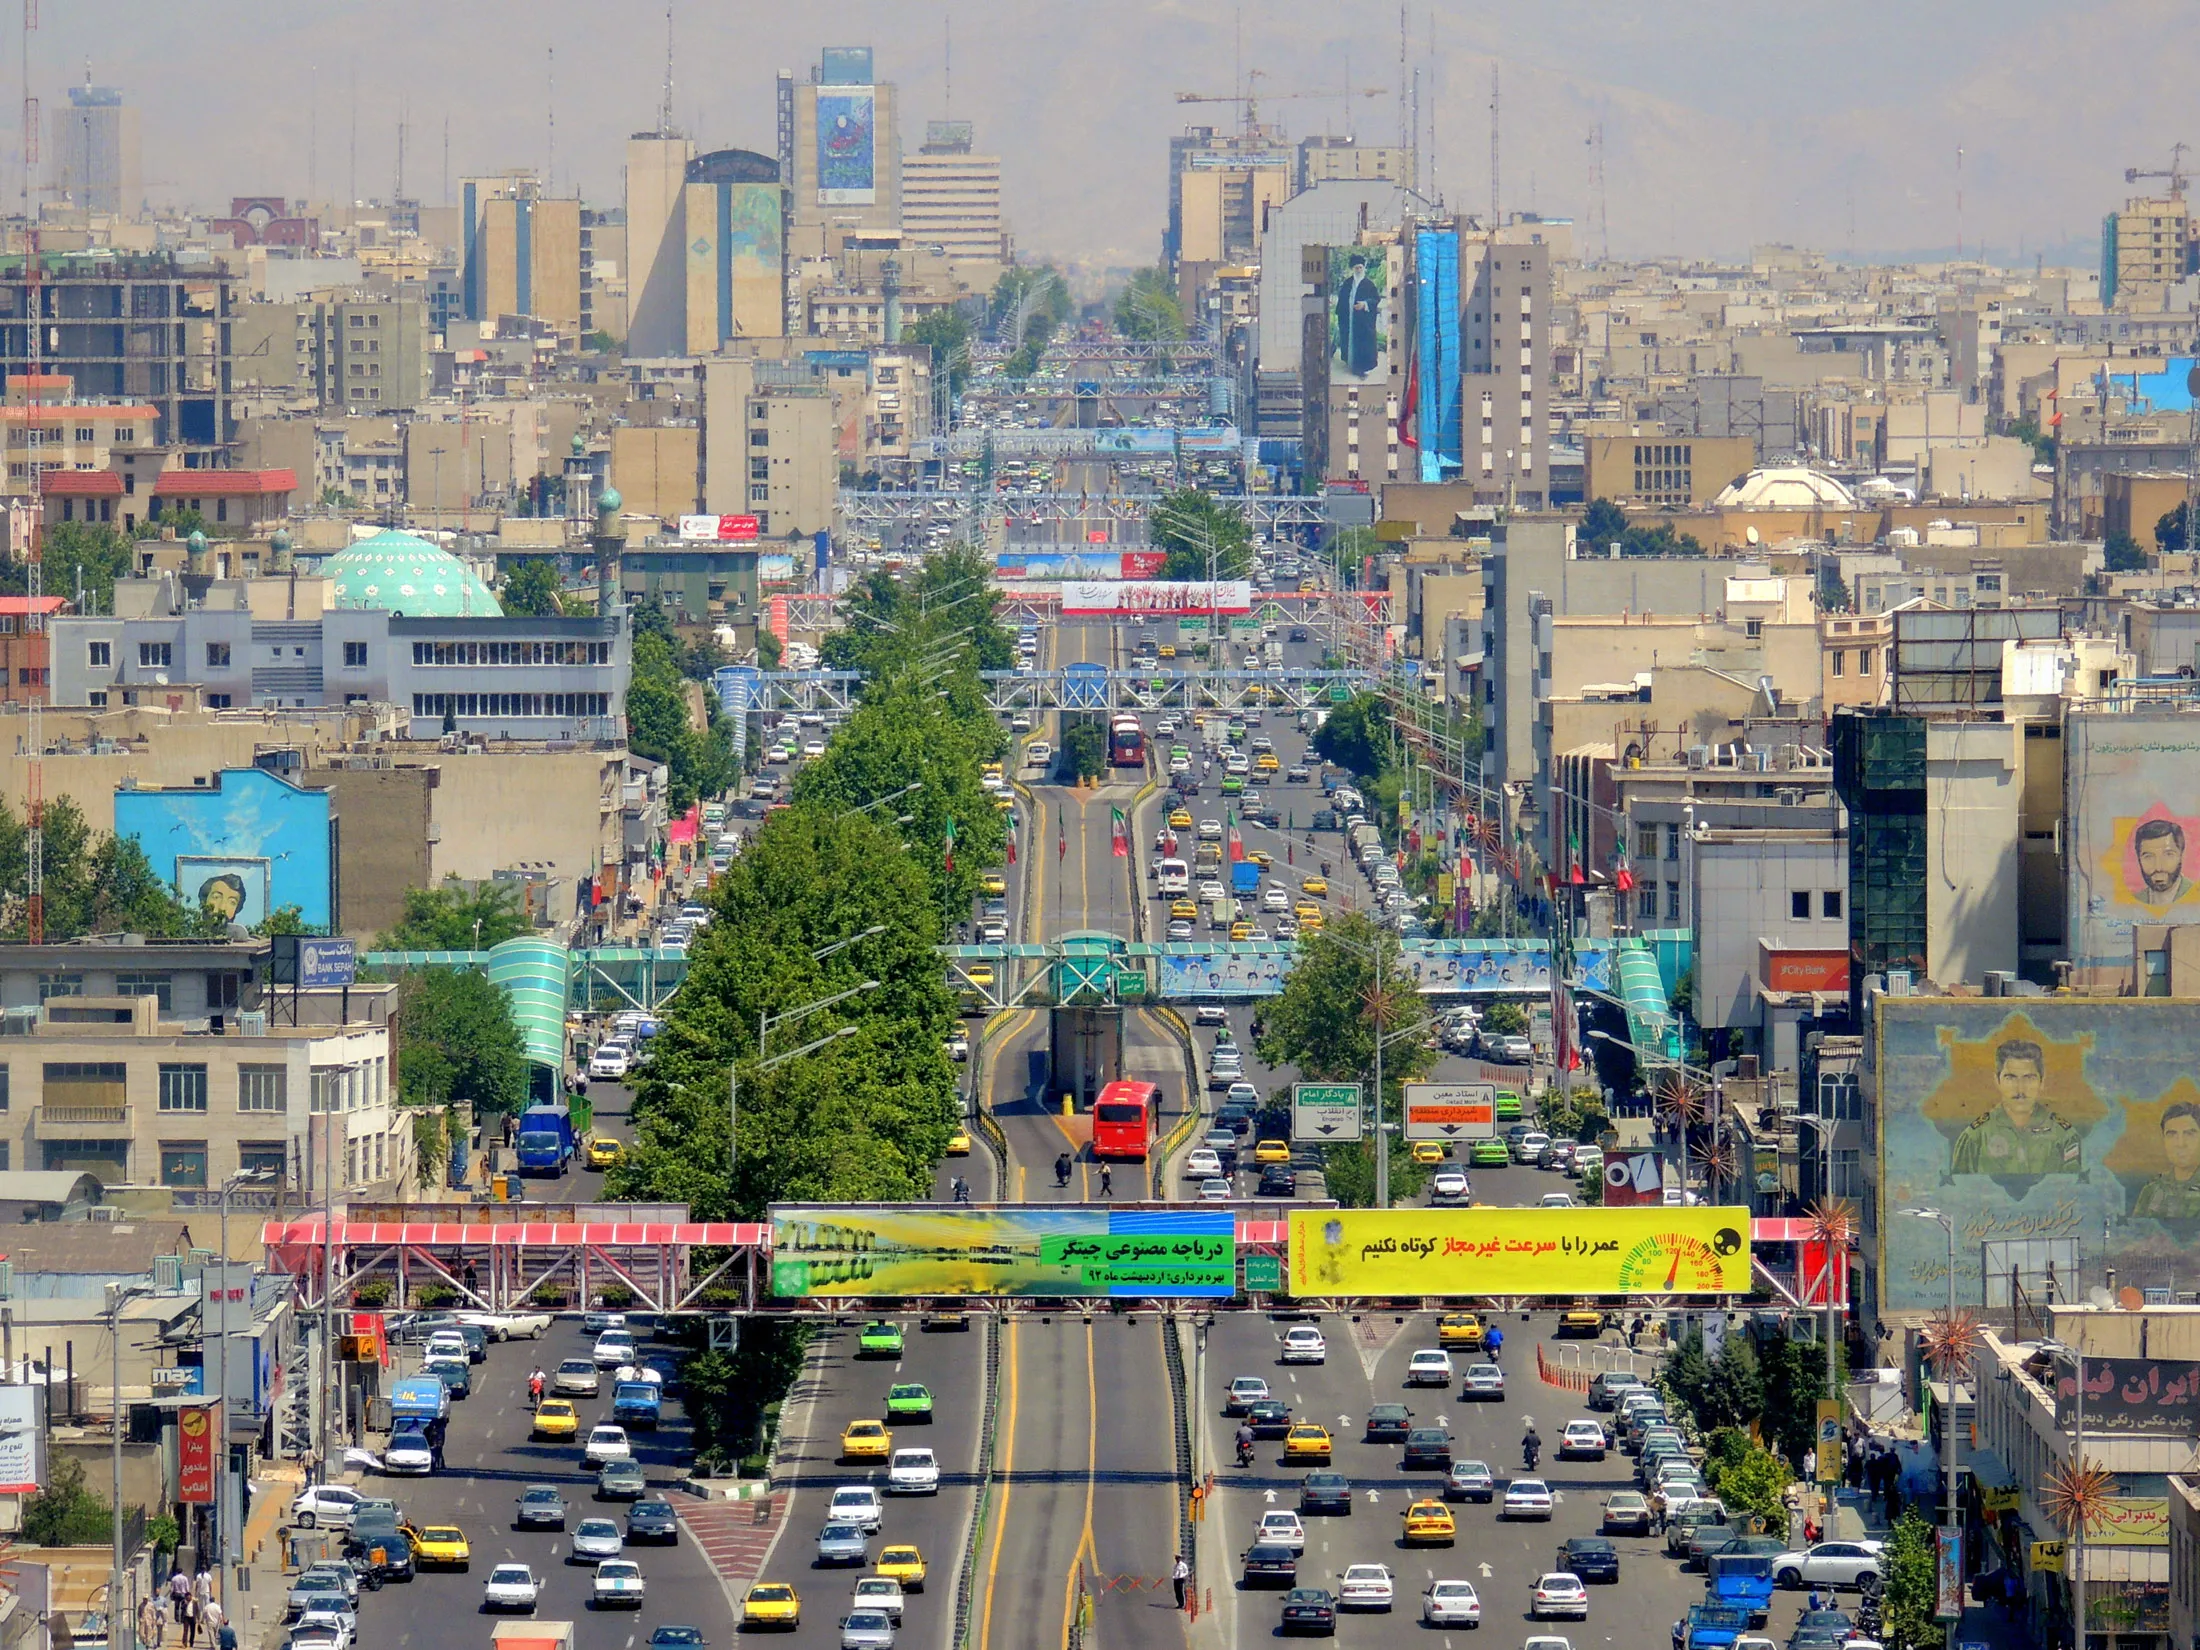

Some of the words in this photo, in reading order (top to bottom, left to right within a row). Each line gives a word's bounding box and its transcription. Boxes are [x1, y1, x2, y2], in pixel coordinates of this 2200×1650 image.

[317, 963, 334, 973] BANK
[334, 962, 352, 973] SEPAH
[1787, 965, 1804, 977] City
[1806, 965, 1827, 975] Bank
[1302, 1090, 1319, 1101] امام
[1320, 1089, 1344, 1101] یادگار
[1433, 1092, 1453, 1100] معین
[1456, 1090, 1478, 1098] استاد
[1317, 1107, 1345, 1116] انقلاب
[1440, 1106, 1478, 1117] شهرداری
[1105, 1241, 1167, 1261] مصنوعی
[1171, 1239, 1223, 1261] دریاچه
[1362, 1237, 1397, 1262] نکنیم
[1400, 1237, 1438, 1259] کوتاه
[1442, 1237, 1476, 1257] مجاز
[1475, 1237, 1501, 1257] غیر
[1504, 1238, 1556, 1256] سرعت
[1561, 1236, 1572, 1256] با
[1575, 1236, 1588, 1256] را
[1589, 1239, 1619, 1256] عمر
[1649, 1249, 1662, 1257] 100
[1665, 1247, 1679, 1255] 120
[1682, 1250, 1696, 1258] 140
[1104, 1271, 1118, 1281] ماه
[1120, 1271, 1164, 1284] اردیبهشت
[1167, 1271, 1203, 1285] برداری:
[1205, 1272, 1225, 1284] بهره
[1635, 1268, 1644, 1276] 60
[2058, 1362, 2115, 1401] فیلم
[2121, 1365, 2200, 1406] ایران
[2106, 1412, 2135, 1428] رنگی
[2137, 1414, 2166, 1428] عکس
[2169, 1415, 2193, 1431] چاپ
[187, 1441, 203, 1454] پیتزا
[182, 1463, 208, 1477] ساندویچ
[182, 1481, 208, 1496] آفتاب
[2112, 1509, 2156, 1524] پذیرایی
[2040, 1542, 2064, 1557] غذا
